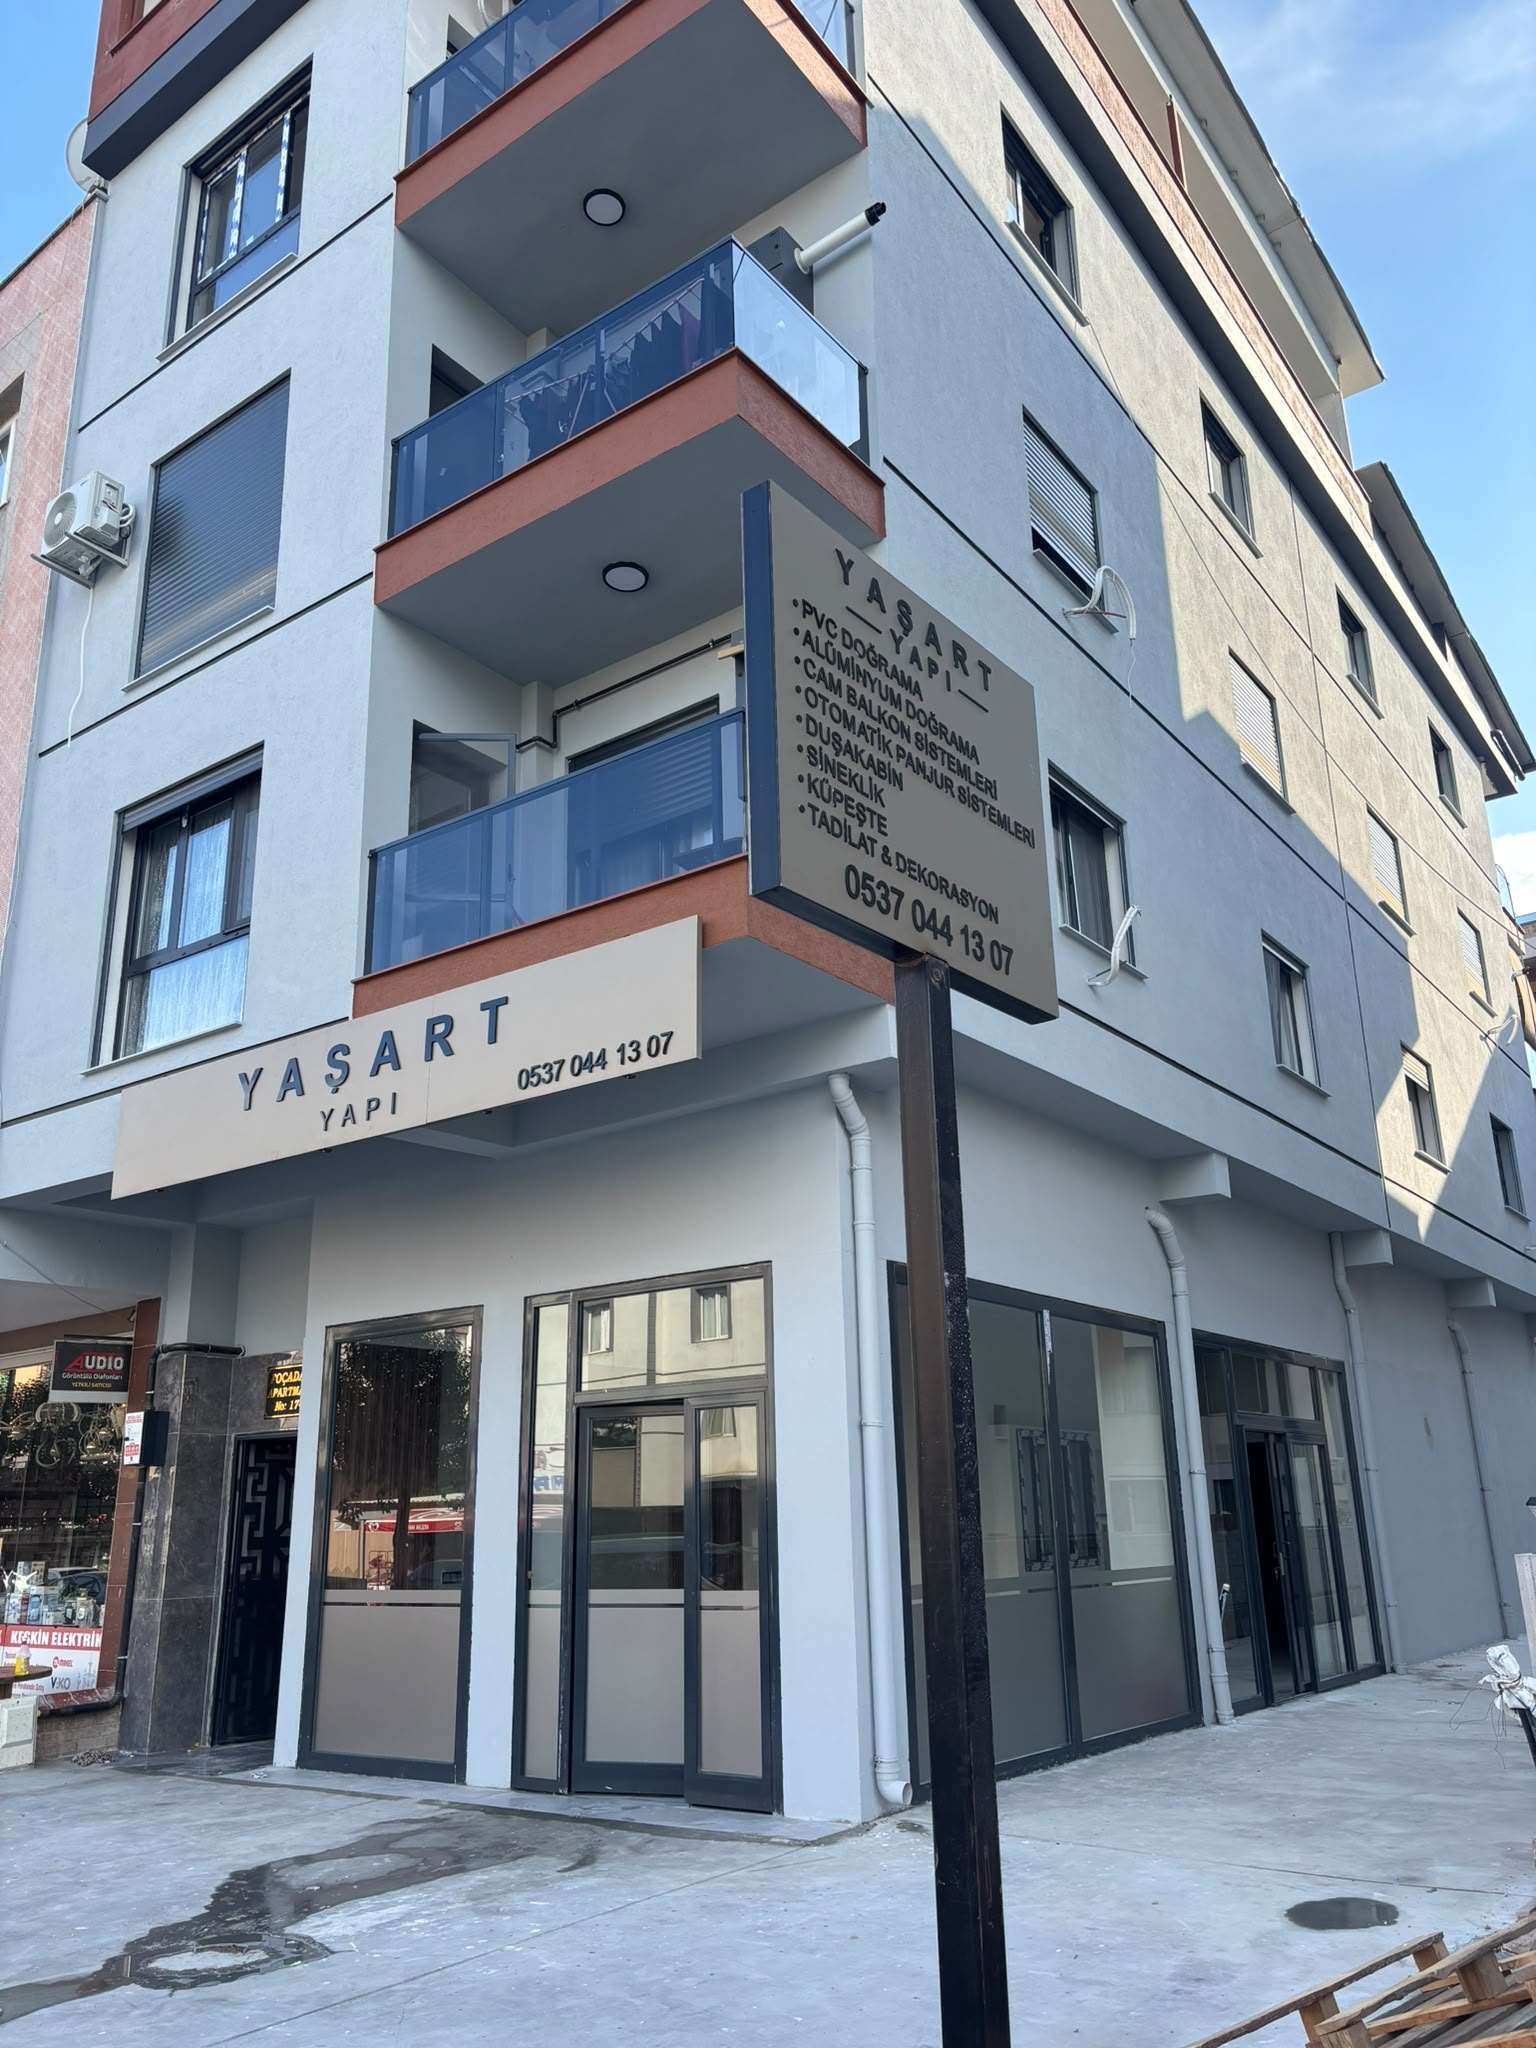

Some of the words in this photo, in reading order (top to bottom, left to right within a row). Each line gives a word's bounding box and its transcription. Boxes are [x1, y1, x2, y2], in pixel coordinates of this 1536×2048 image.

[802, 599, 837, 639] PVC
[841, 626, 923, 701] DOĞRAMA
[835, 548, 992, 692] YAŞART
[890, 628, 951, 692] YAPI
[803, 629, 902, 712] ALÜMİNYUM
[906, 699, 980, 765] DOĞRAMA
[804, 658, 842, 698] CAM
[847, 685, 911, 744] BALKON
[914, 729, 998, 800] SİSTEMLERİ
[805, 687, 893, 752] OTOMATİK
[896, 745, 955, 801] PANJUR
[958, 785, 1035, 849] SİSTEMLERİ
[806, 715, 903, 791] DUŞAKABİN
[806, 745, 886, 808] SİNEKLİK
[807, 774, 888, 837] KÜPEŞTE
[808, 803, 877, 858] TADİLAT
[881, 846, 892, 867] &
[896, 852, 999, 925] DEKORASYON
[845, 864, 904, 921] 0537
[911, 899, 952, 947] 044
[960, 924, 985, 963] 13
[990, 940, 1014, 975] 07
[238, 996, 510, 1111] YAŞART
[517, 1059, 566, 1090] 0537
[570, 1047, 607, 1077] 044
[615, 1037, 641, 1066] 13
[646, 1031, 674, 1058] 07
[320, 1092, 398, 1132] YAPI
[64, 1352, 124, 1371] AUDIO
